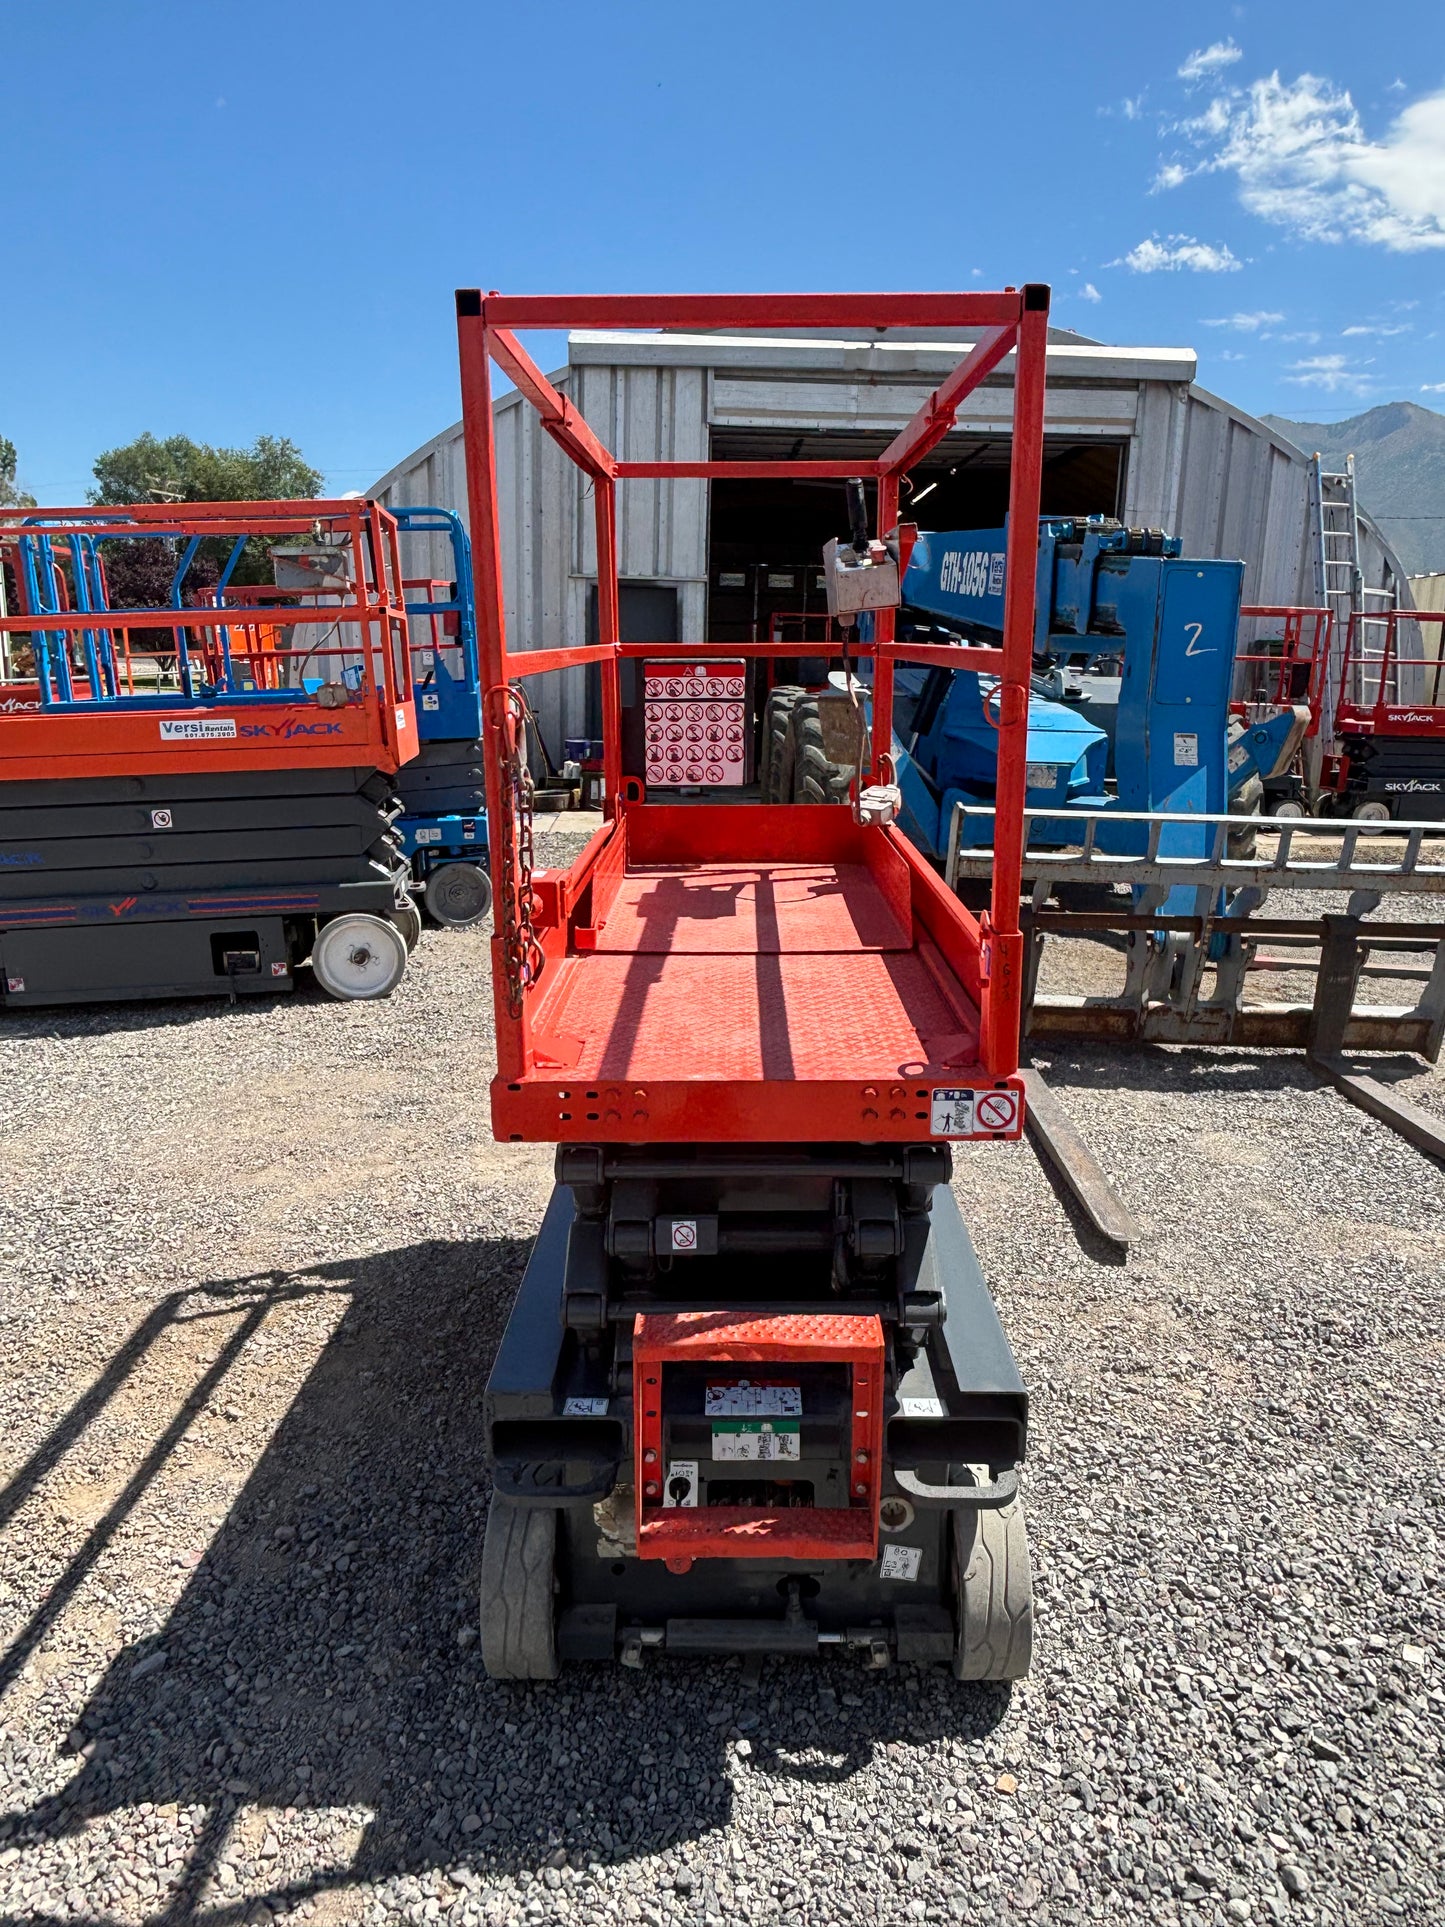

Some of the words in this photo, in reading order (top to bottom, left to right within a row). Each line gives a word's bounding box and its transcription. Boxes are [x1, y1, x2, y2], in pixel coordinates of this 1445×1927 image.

[941, 552, 990, 598] GTH-1056
[1184, 622, 1218, 657] 2
[1388, 711, 1434, 723] SKYJACK
[162, 721, 204, 734] Versi
[240, 718, 344, 739] SKYJACK
[1385, 779, 1441, 792] SKYJACK
